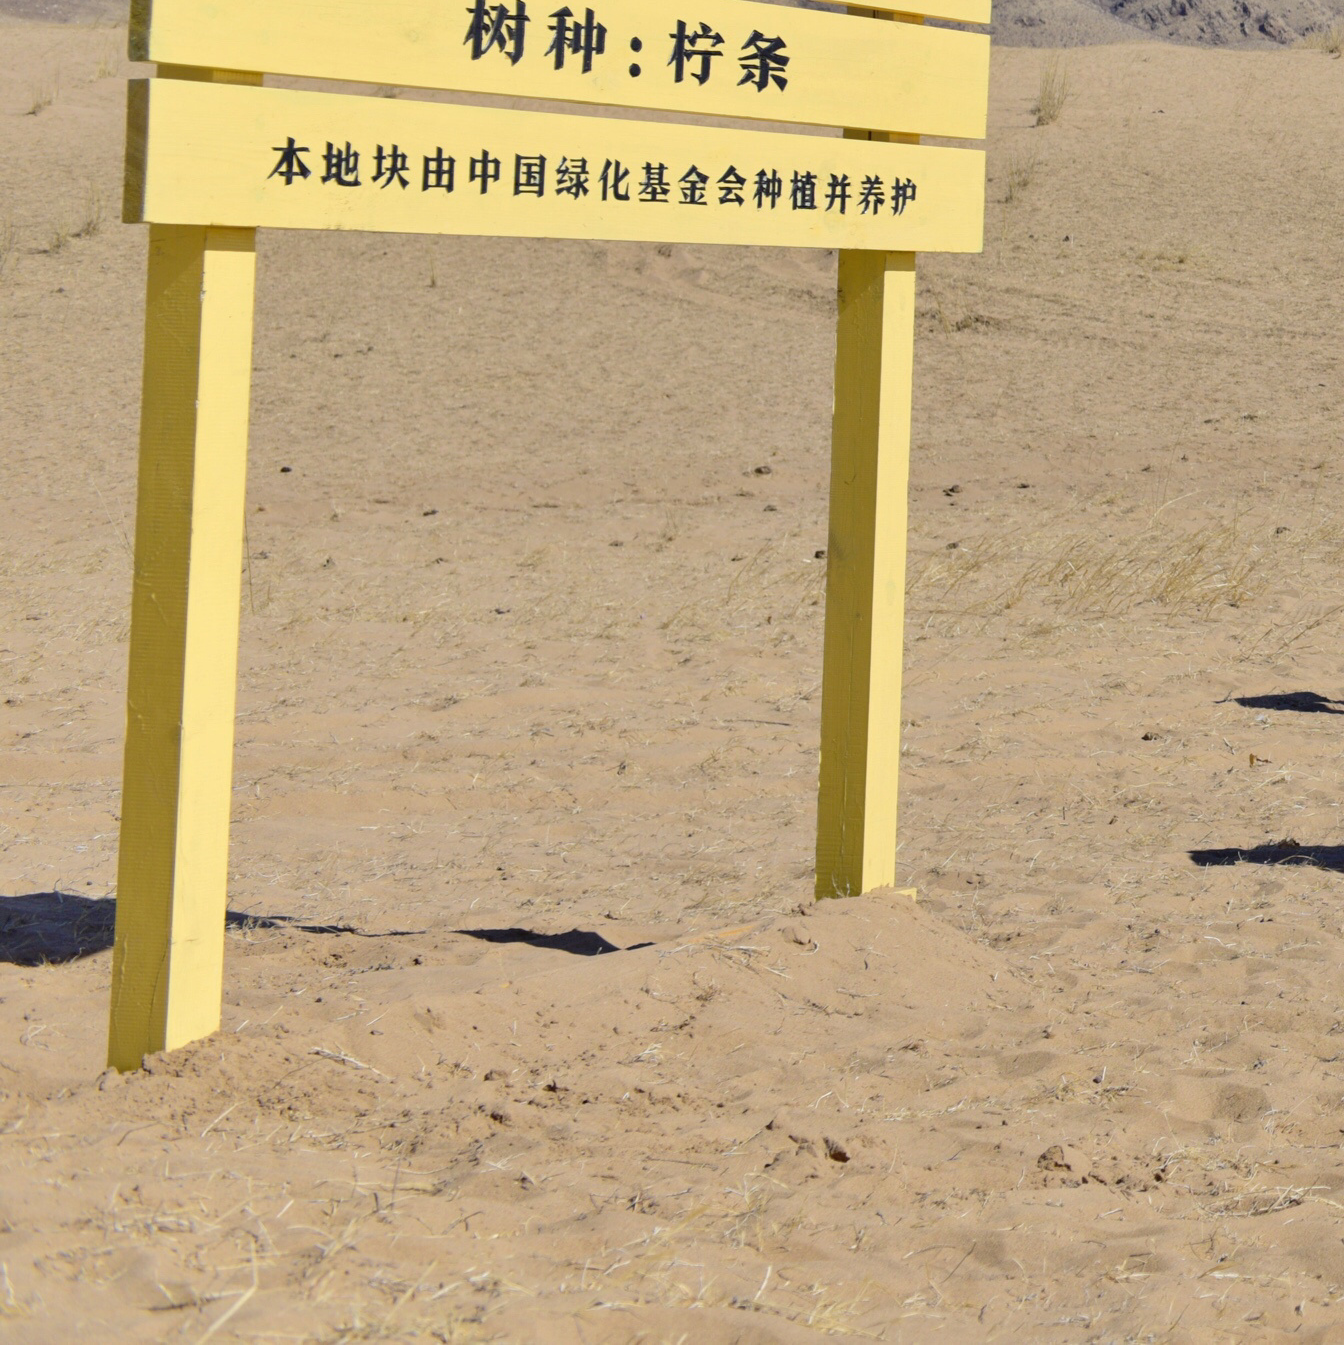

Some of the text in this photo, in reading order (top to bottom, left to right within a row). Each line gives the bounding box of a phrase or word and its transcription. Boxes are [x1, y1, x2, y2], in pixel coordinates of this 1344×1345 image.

[267, 136, 918, 217] 本地块由中国绿化基金会种植并养护
